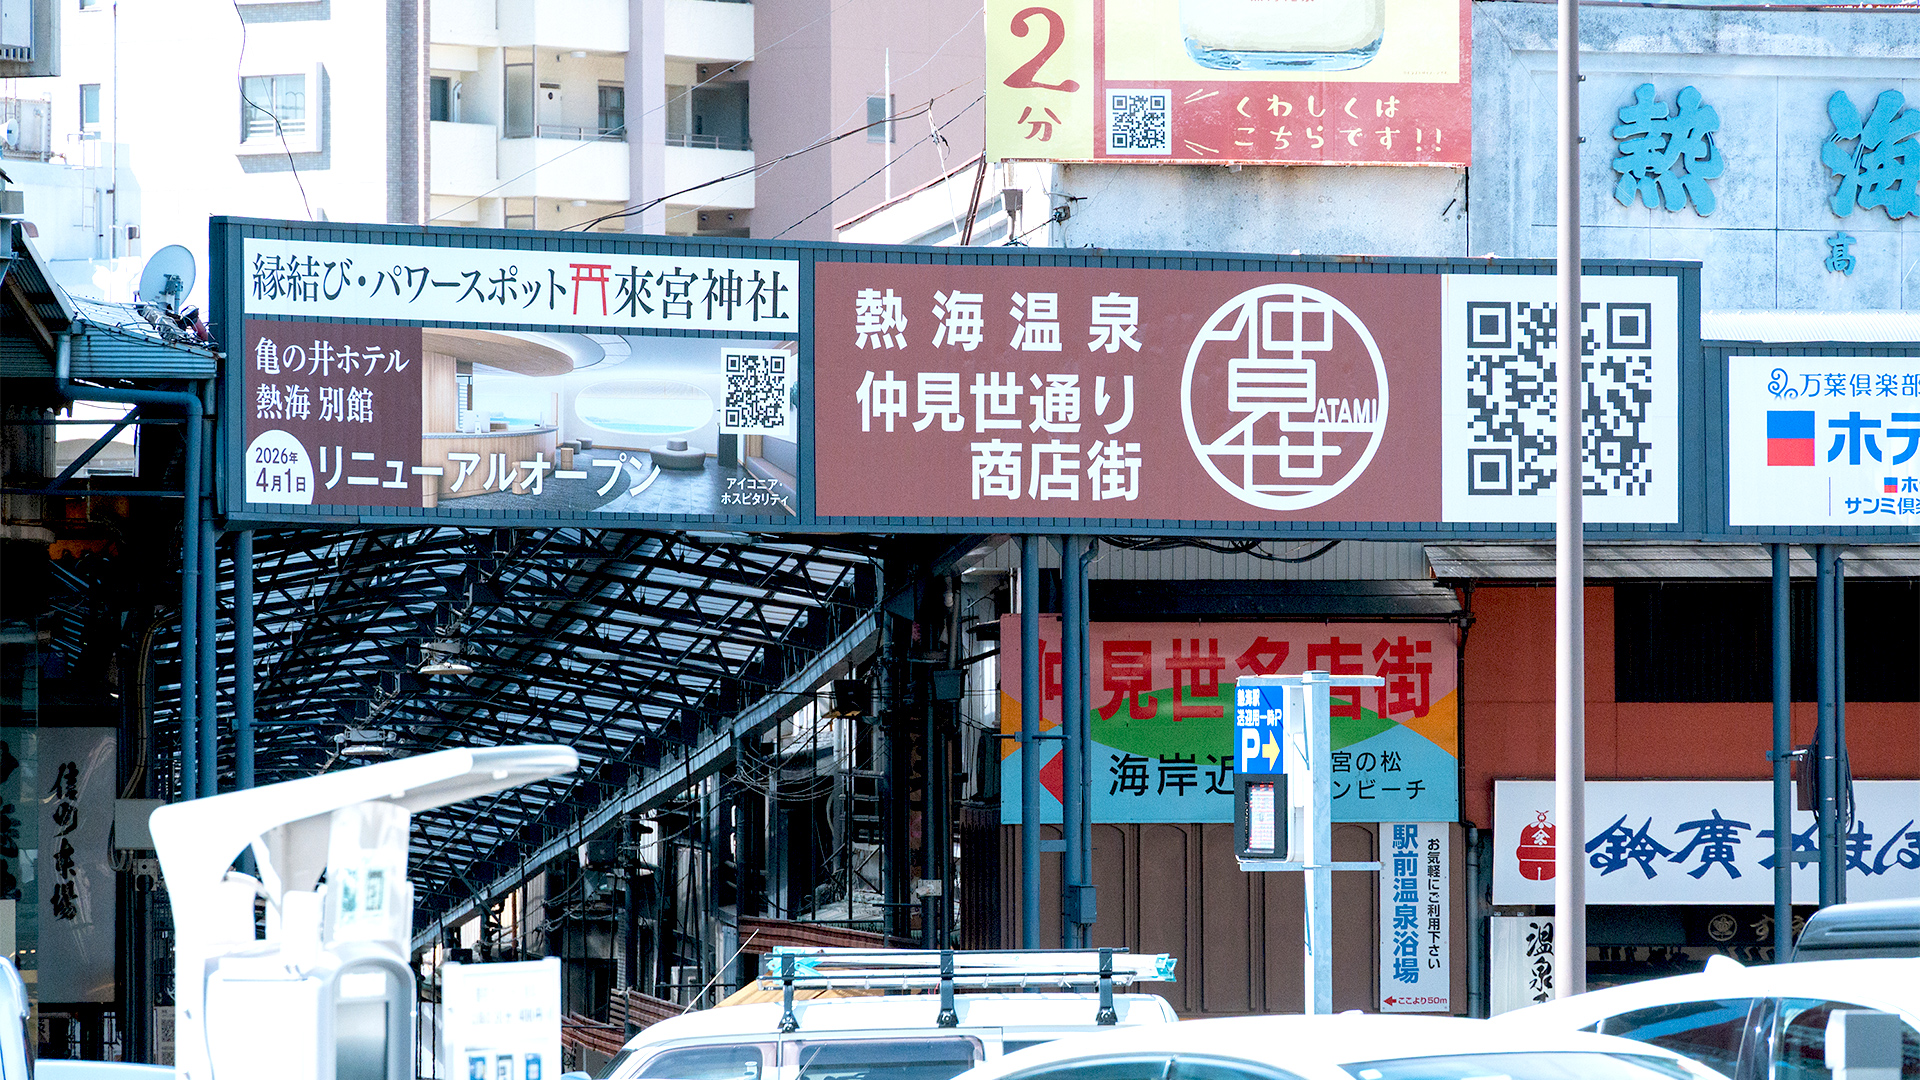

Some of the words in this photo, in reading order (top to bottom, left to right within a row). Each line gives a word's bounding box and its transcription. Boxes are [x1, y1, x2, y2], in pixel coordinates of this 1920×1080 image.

[1236, 95, 1400, 118] くわしくは
[1234, 126, 1442, 152] こちらです!!
[1612, 83, 1920, 220] 熱海
[1824, 231, 1857, 276] 高
[252, 252, 566, 310] 縁結び・パワースポット
[613, 265, 790, 322] 來宮神社
[855, 288, 1143, 353] 熱海温泉
[254, 336, 411, 377] 亀の井ホテル
[256, 383, 311, 421] 熱海
[318, 386, 374, 424] 別館
[855, 370, 1135, 434] 仲見世通り
[1314, 398, 1377, 423] ATAMI
[255, 447, 299, 465] 2026年
[318, 446, 661, 498] リニューアルオープン
[970, 438, 1143, 501] 商店街
[255, 467, 307, 493] 4月1日
[720, 492, 789, 507] ホスピタリティ
[1901, 477, 1920, 493] ホ
[1844, 497, 1920, 515] サンミ倶
[1241, 727, 1261, 773] P
[1331, 750, 1402, 773] 宮の松
[1332, 779, 1426, 799] ンビーチ
[1392, 824, 1420, 984] 駅前温泉浴場
[1427, 838, 1441, 970] お気軽にご利用下さい
[1398, 996, 1448, 1005] ここより50m
